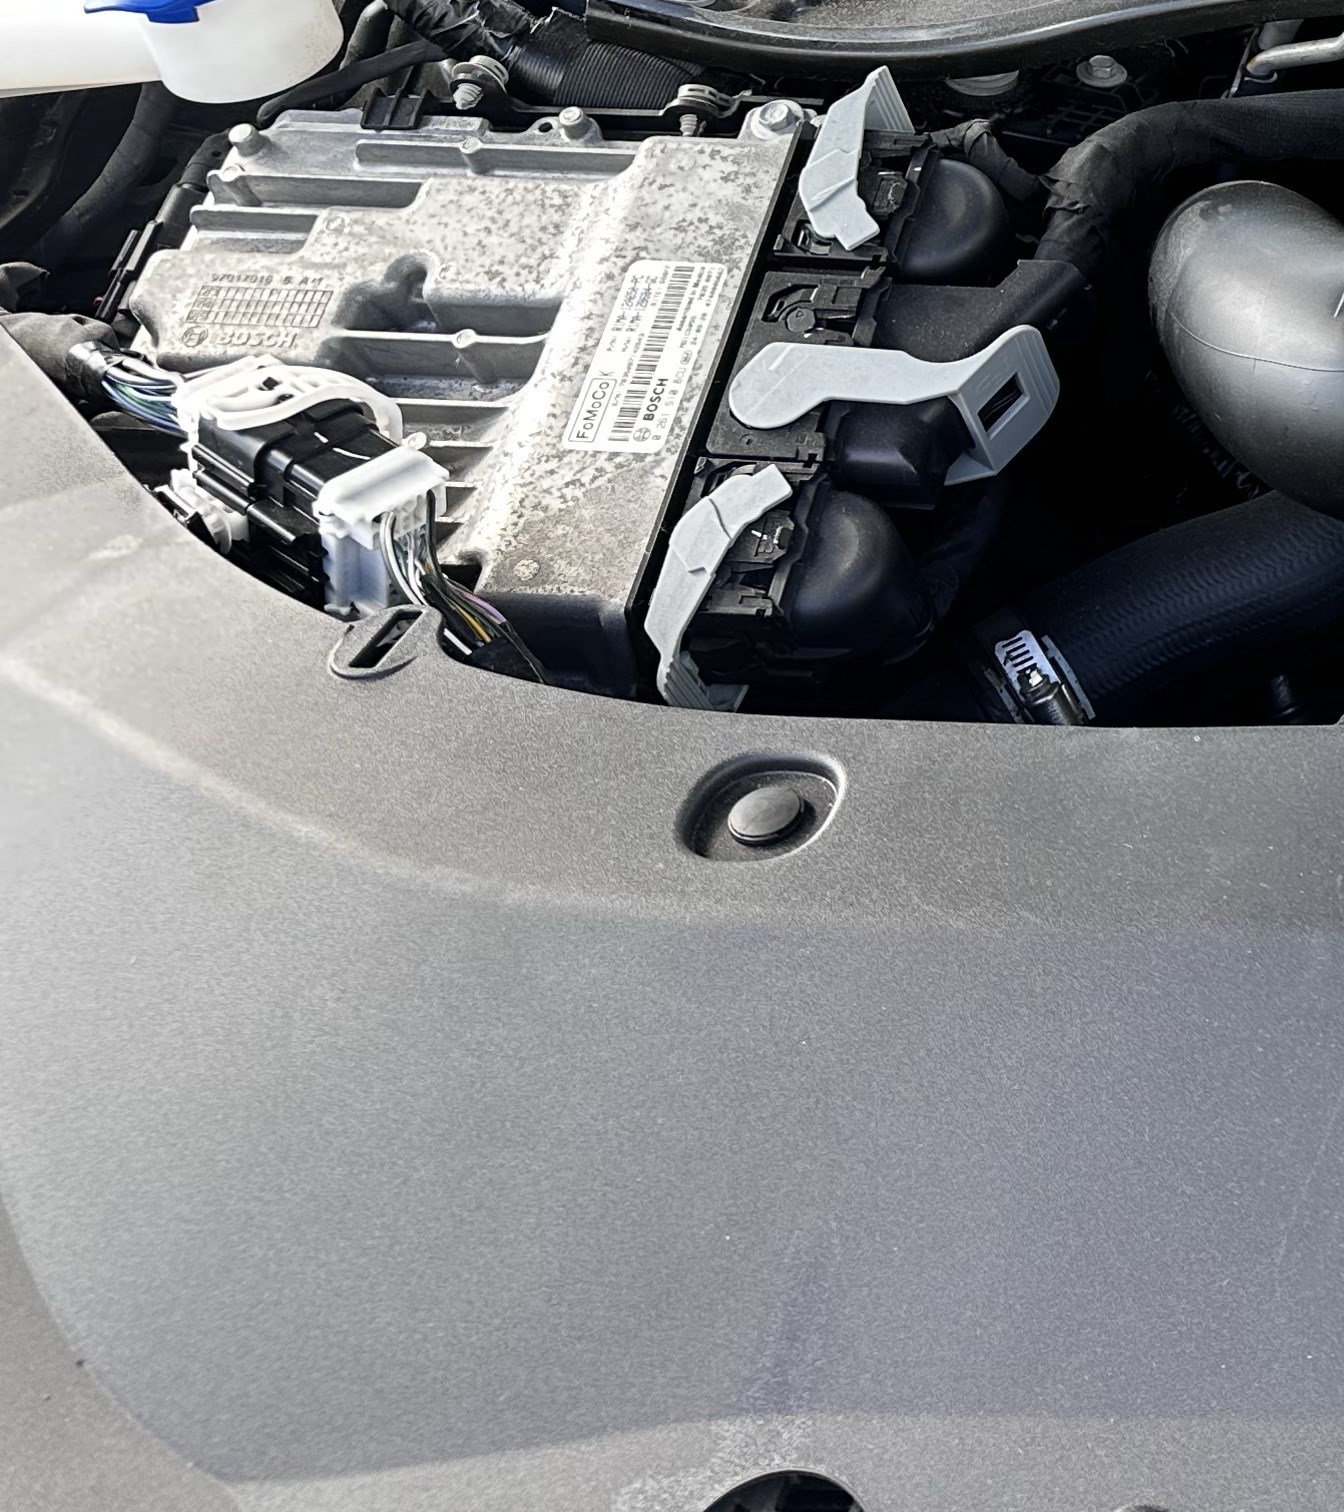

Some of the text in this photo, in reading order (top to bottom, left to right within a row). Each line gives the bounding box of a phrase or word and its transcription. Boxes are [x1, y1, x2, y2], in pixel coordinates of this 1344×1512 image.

[216, 331, 298, 349] BOSCH
[576, 381, 610, 439] FoMoCo
[642, 378, 668, 421] BOSCH
